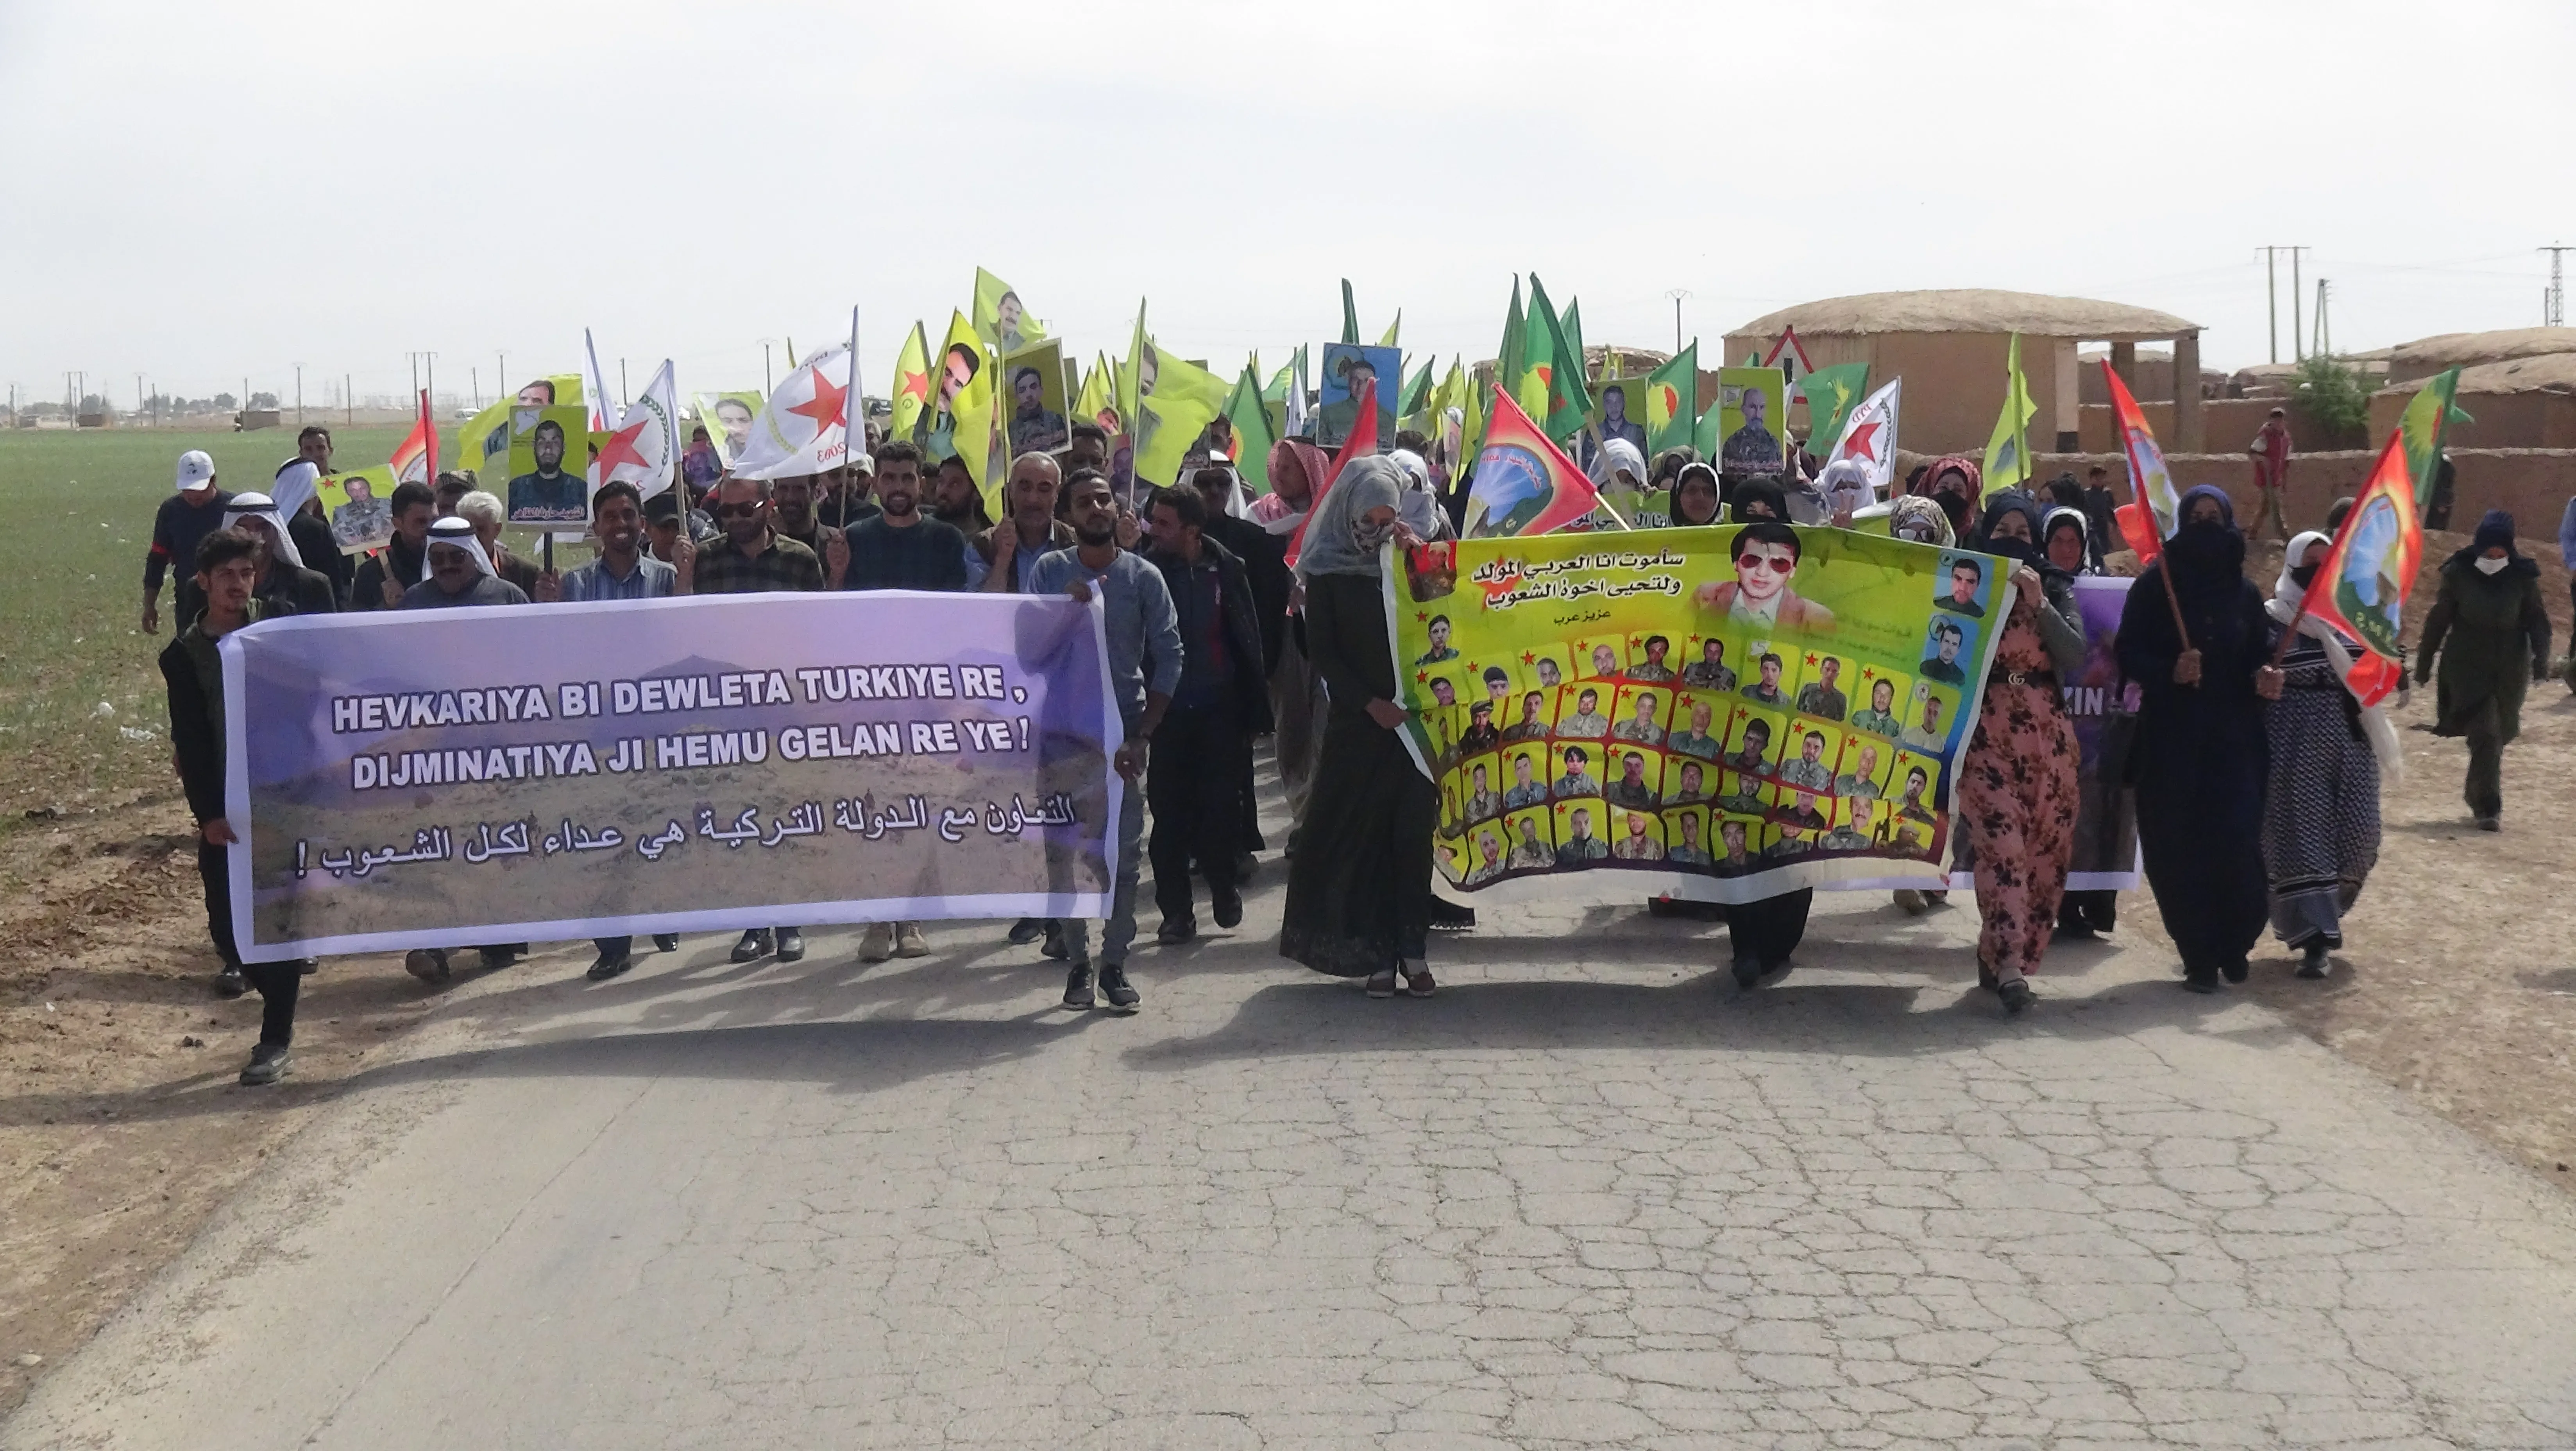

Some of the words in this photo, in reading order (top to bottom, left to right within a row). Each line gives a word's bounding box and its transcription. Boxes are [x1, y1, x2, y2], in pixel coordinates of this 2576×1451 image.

[1474, 560, 1521, 581] المولد
[1524, 555, 1589, 580] العربي
[1596, 554, 1615, 567] انا
[1619, 549, 1683, 570] سأموت
[1488, 583, 1556, 609] الشعوب
[1554, 614, 1580, 626] عرب
[1582, 609, 1611, 622] عزيز
[335, 688, 549, 730] HEVKARIYA
[562, 684, 599, 716] BI
[615, 673, 790, 713] DEWLETA
[799, 668, 953, 700] TURKIYE
[355, 744, 596, 788] DIJMINATIYA
[609, 740, 642, 771] JI
[658, 729, 766, 768] HEMU
[781, 724, 900, 759] GELAN
[911, 724, 958, 752] RE
[700, 804, 822, 847] التركية
[837, 797, 926, 838] الدولة
[940, 810, 976, 840] مع
[987, 793, 1074, 833] التعاون
[467, 822, 529, 862] لكل
[545, 820, 622, 853] عداء
[639, 822, 684, 858] هي
